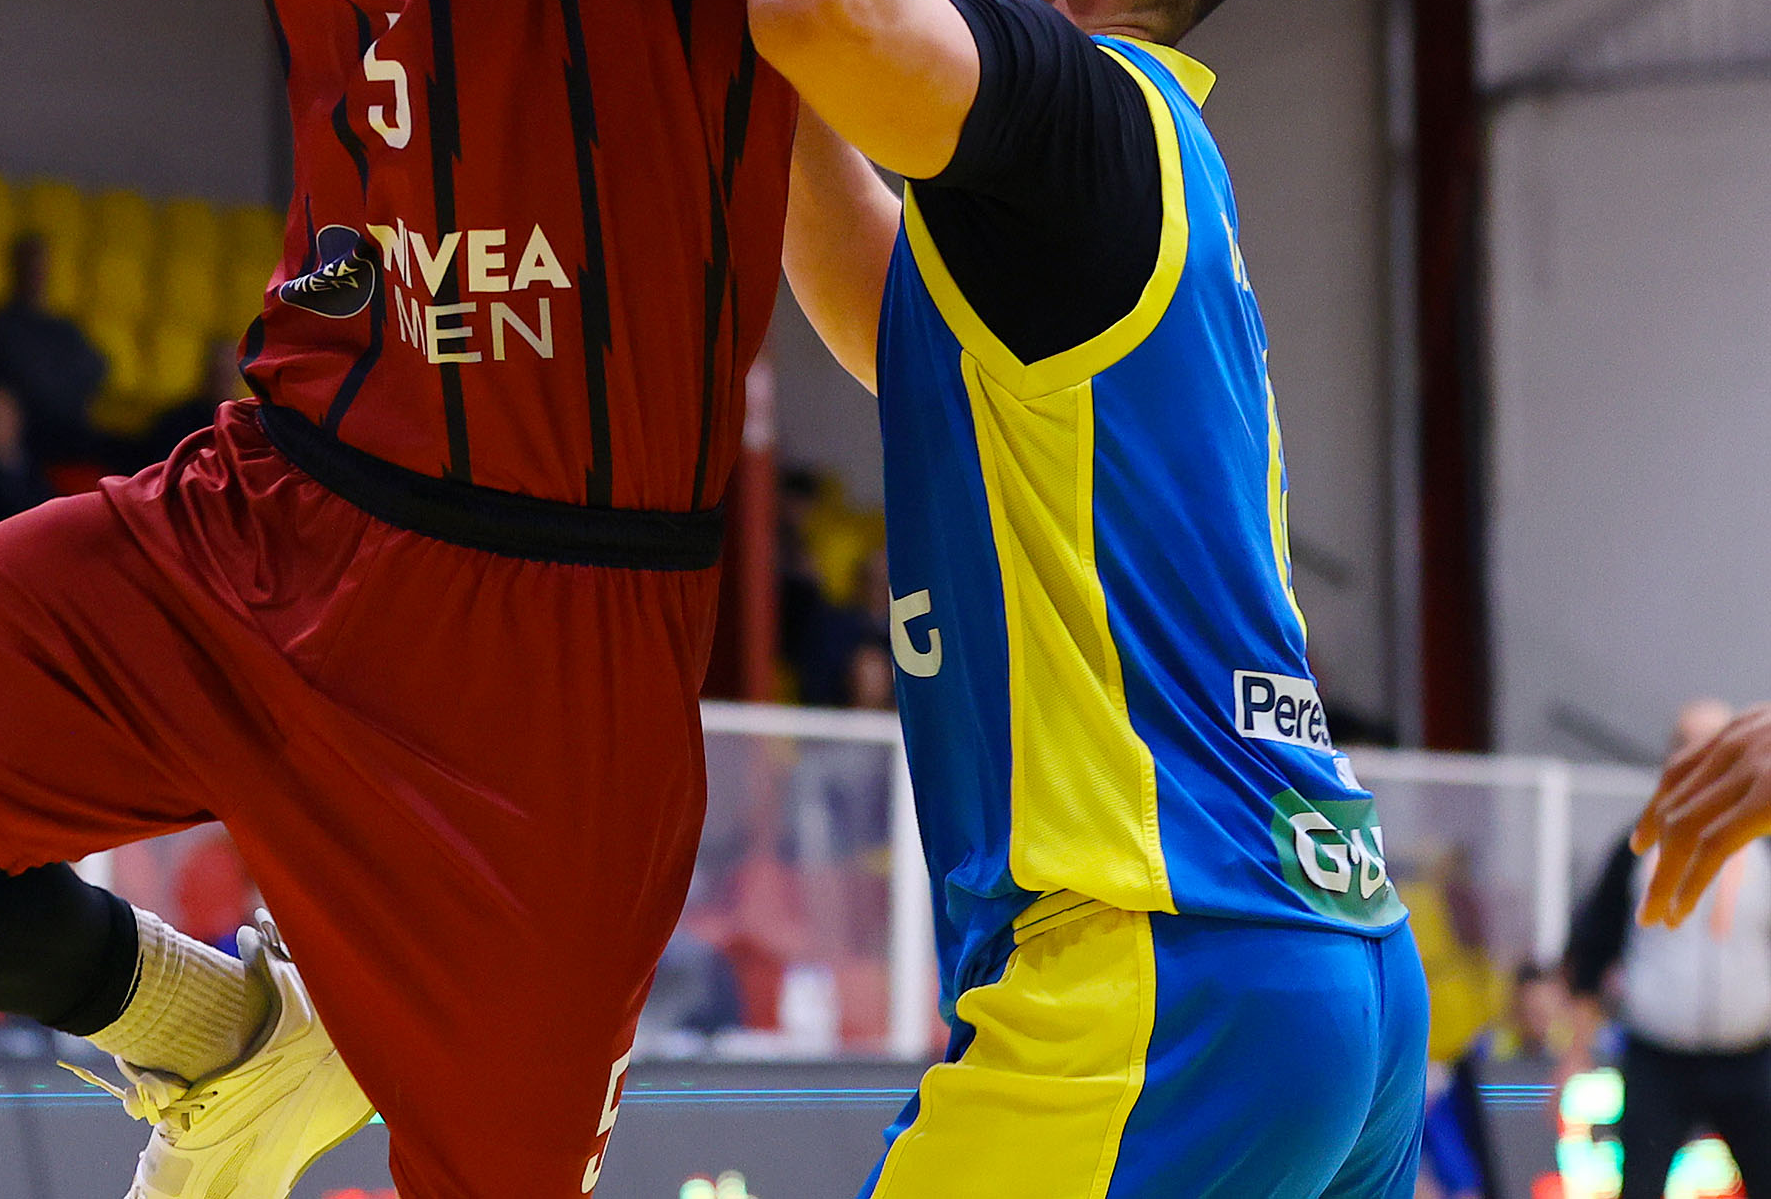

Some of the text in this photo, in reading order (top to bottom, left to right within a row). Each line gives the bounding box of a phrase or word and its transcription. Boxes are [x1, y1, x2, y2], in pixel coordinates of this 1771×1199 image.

[363, 11, 412, 150] 5
[365, 216, 572, 298] NIVEA
[394, 284, 554, 364] MEN
